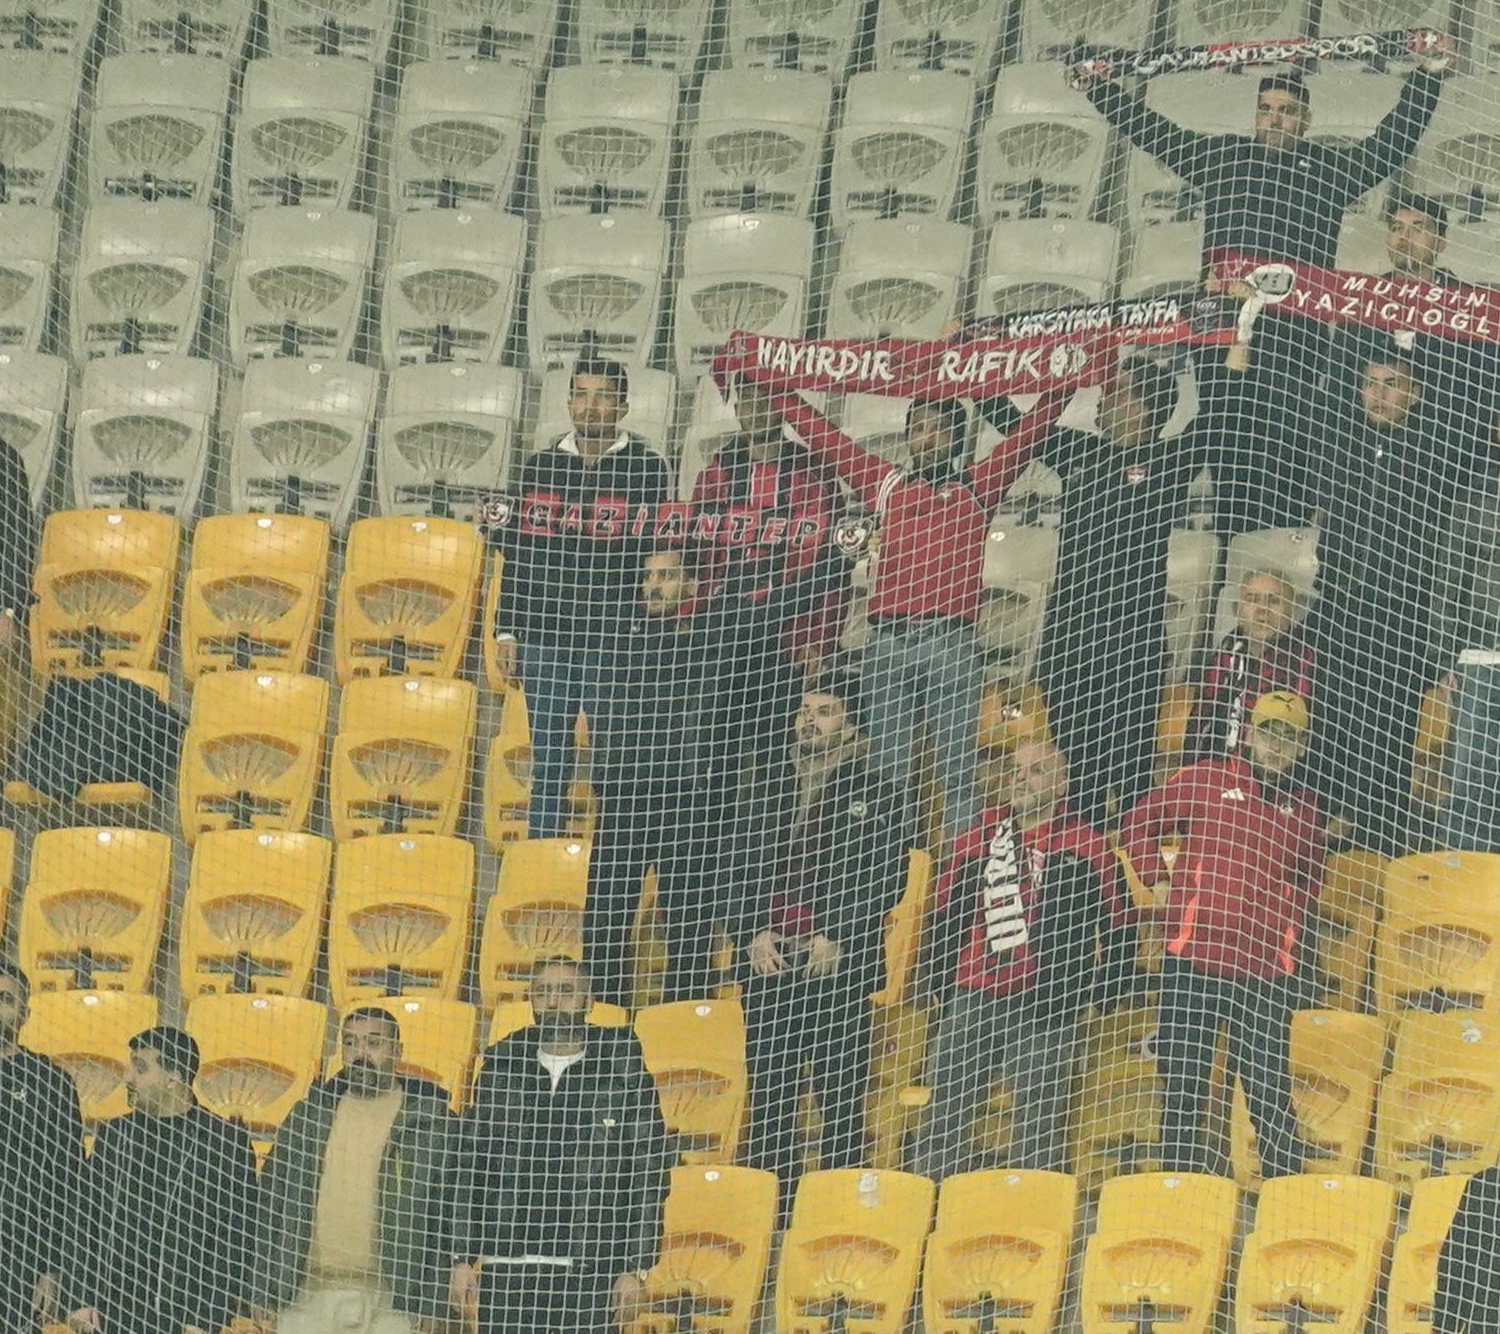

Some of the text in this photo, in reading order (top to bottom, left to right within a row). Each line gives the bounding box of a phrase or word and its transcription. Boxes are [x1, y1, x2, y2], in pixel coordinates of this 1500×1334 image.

[1118, 299, 1181, 327] TAYFA
[757, 336, 1046, 384] HAYIRDIR RAFIK
